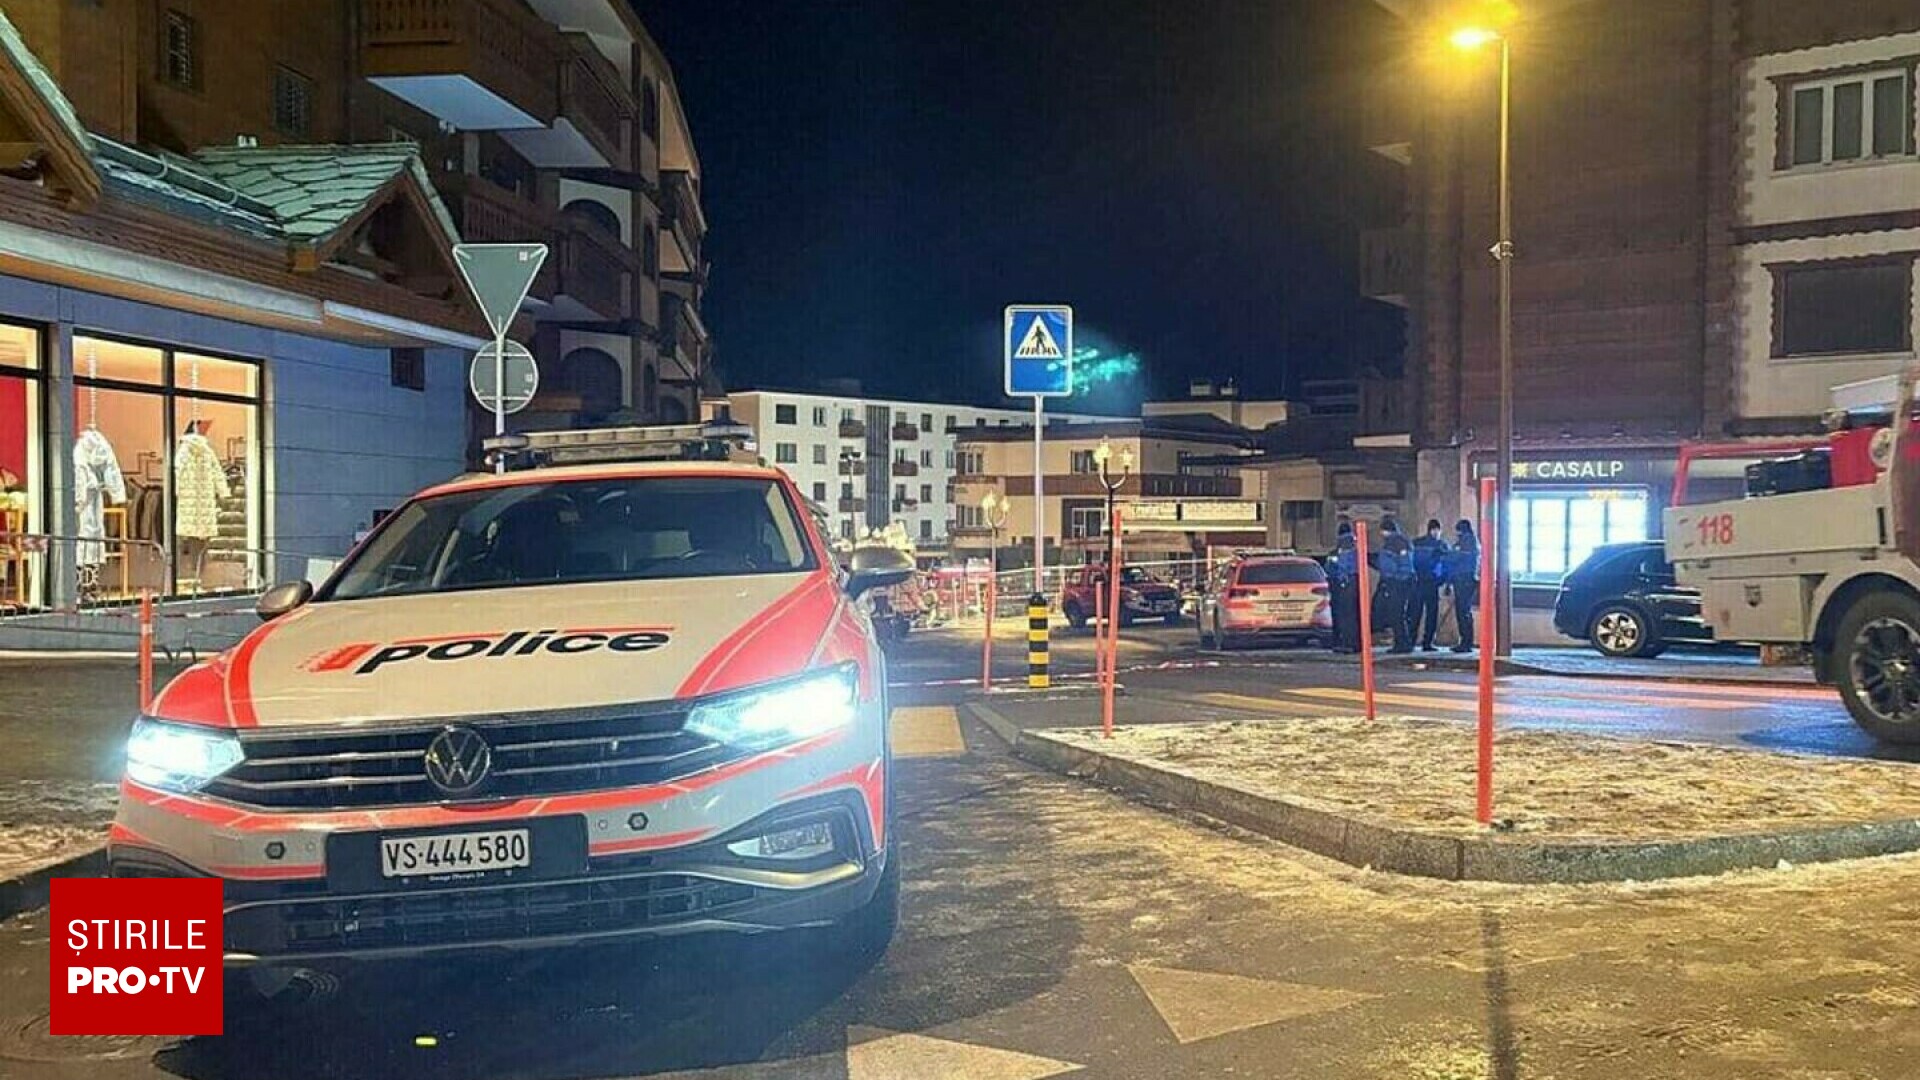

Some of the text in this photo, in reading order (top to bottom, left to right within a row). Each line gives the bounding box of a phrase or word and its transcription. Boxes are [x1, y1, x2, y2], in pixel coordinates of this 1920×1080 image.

[1536, 461, 1623, 478] CASALP
[1697, 513, 1734, 545] 118
[355, 629, 669, 674] police
